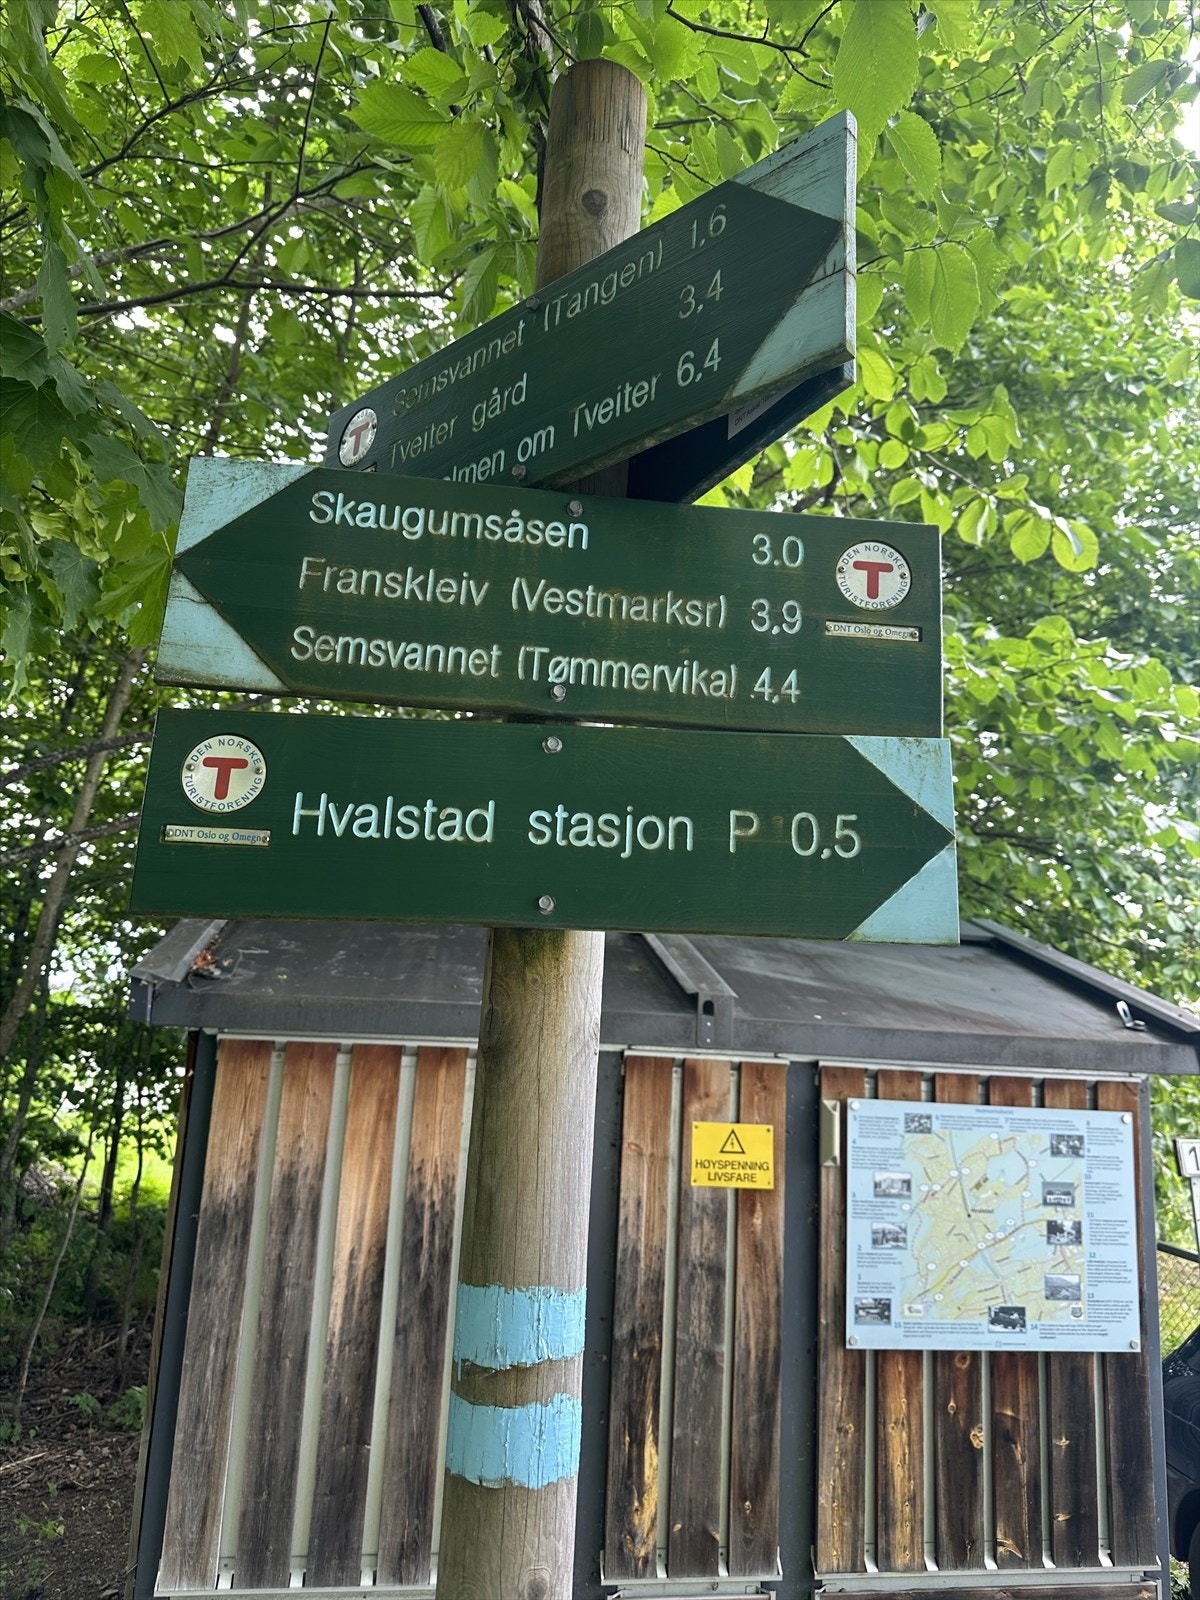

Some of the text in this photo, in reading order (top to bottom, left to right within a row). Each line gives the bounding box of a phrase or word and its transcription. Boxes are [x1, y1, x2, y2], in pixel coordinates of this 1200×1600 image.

[393, 203, 727, 417] Semsvannet (Tangen) 1,6
[390, 415, 458, 469] Tveiter
[471, 371, 528, 433] gård
[678, 269, 724, 320] 3,4
[517, 424, 555, 463] om
[571, 373, 661, 438] Tveiter
[676, 337, 721, 387] 6,4
[309, 490, 590, 550] Skaugumsåsen
[841, 544, 906, 571] DEN NORSKE
[299, 556, 489, 606] Franskleiv
[511, 576, 727, 629] (Vestmarksr)
[838, 575, 908, 609] TURISTFORENING
[853, 560, 894, 600] T
[833, 624, 851, 633] DNT
[853, 625, 871, 635] Oslo
[873, 628, 883, 637] og
[290, 625, 502, 678] Semsvannet
[517, 645, 737, 699] (Tømmervika)
[190, 738, 262, 766] DEN NORSKE
[184, 773, 263, 811] TURISTFORENING
[202, 756, 249, 801] T
[174, 828, 261, 843] DNT Oslo og Omegn
[292, 791, 861, 860] Hvalstad stasjon P 0,5
[695, 1159, 769, 1171] HØYSPENNING
[708, 1171, 757, 1183] LIVSFARE
